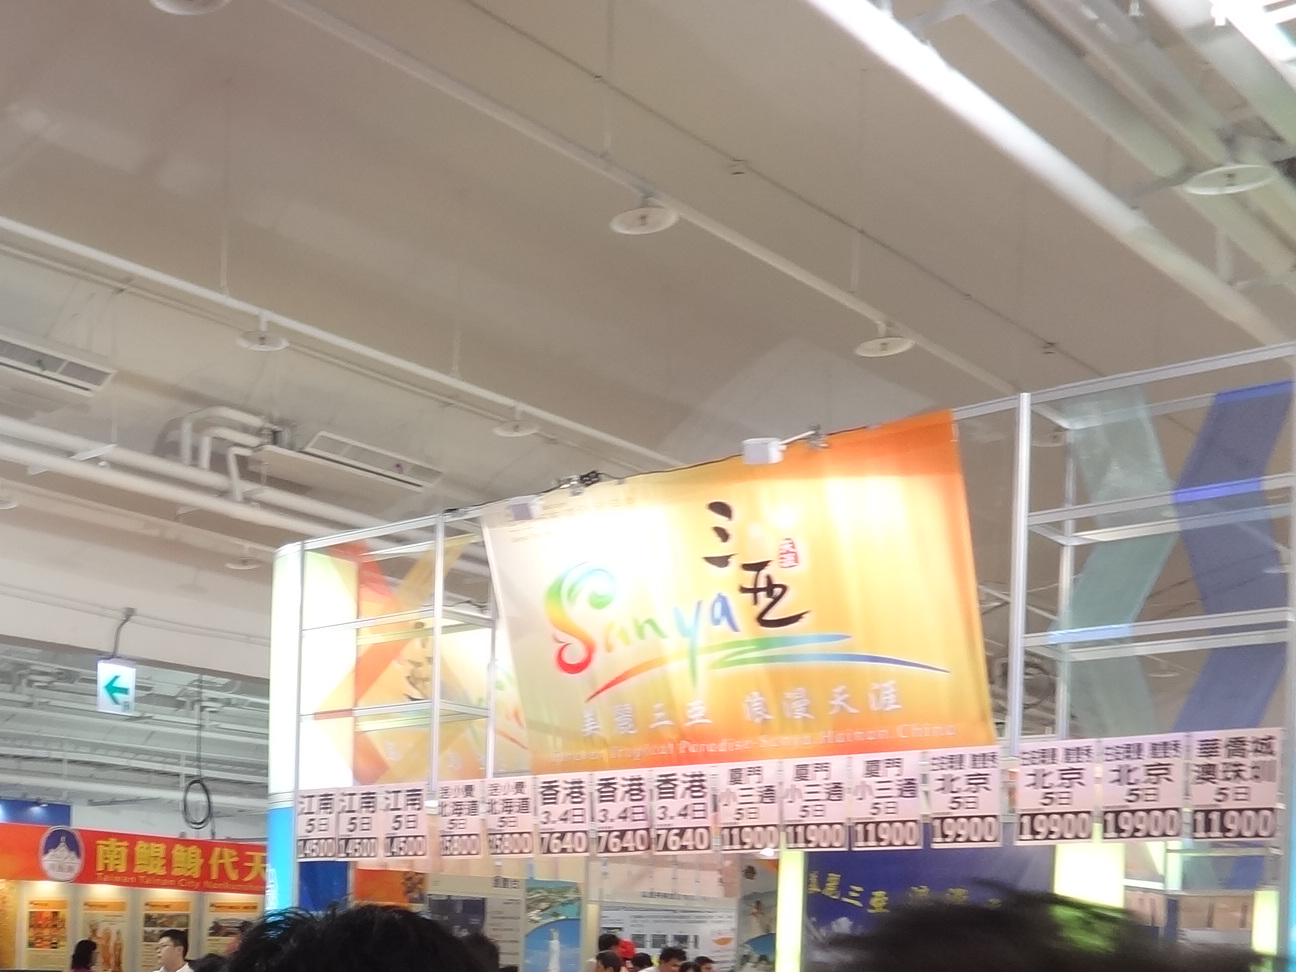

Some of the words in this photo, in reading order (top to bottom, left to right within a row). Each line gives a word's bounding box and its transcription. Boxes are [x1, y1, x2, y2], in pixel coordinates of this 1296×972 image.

[544, 562, 740, 687] Sanya
[935, 773, 992, 794] 北京
[1025, 767, 1086, 789] 北京
[1110, 762, 1174, 786] 北京
[540, 779, 584, 805] 香港
[597, 776, 645, 803] 香港
[656, 772, 706, 800] 香港
[718, 785, 776, 806] 小三通
[784, 782, 844, 803] 小三通
[854, 778, 917, 800] 小三通
[1124, 787, 1160, 803] 5日
[1213, 786, 1251, 803] 5日
[300, 792, 334, 815] 江南
[339, 790, 376, 814] 江南
[384, 788, 423, 812] 江南
[948, 796, 979, 810] 5日
[1040, 791, 1073, 806] 5日
[855, 821, 919, 847] 11900
[933, 816, 999, 842] 19900
[1019, 811, 1092, 840] 19900
[1104, 808, 1181, 839] 19900
[1193, 808, 1276, 839] 11900
[540, 832, 587, 854] 7640
[598, 829, 649, 852] 7640
[656, 827, 710, 850] 7640
[722, 826, 779, 849] 11900
[786, 823, 846, 848] 11900
